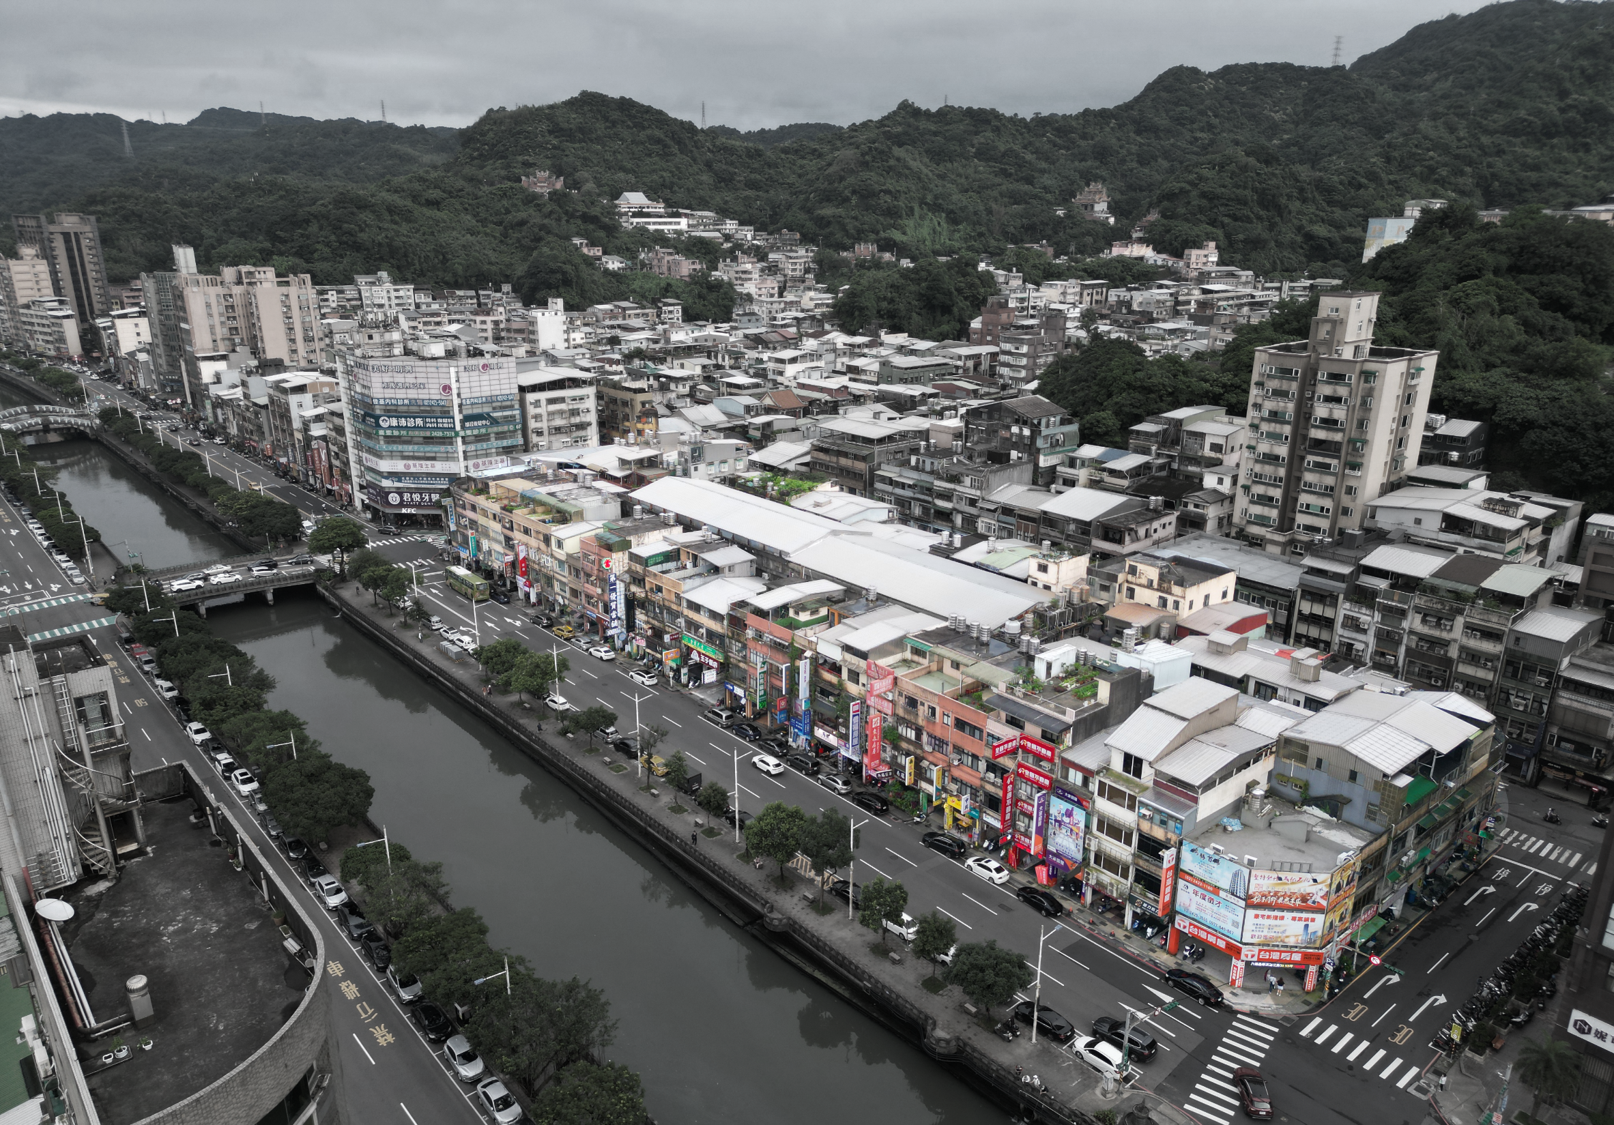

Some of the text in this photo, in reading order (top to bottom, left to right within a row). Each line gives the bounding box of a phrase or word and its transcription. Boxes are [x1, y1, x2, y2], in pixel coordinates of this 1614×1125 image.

[134, 698, 149, 708] 50
[1491, 867, 1511, 881] 停
[1535, 882, 1554, 896] 停
[1188, 924, 1227, 950] 台灣房屋
[1258, 950, 1303, 961] 台灣房屋
[326, 960, 396, 1047] 禁行機車
[1341, 1002, 1369, 1022] 30
[1387, 1024, 1414, 1045] 30
